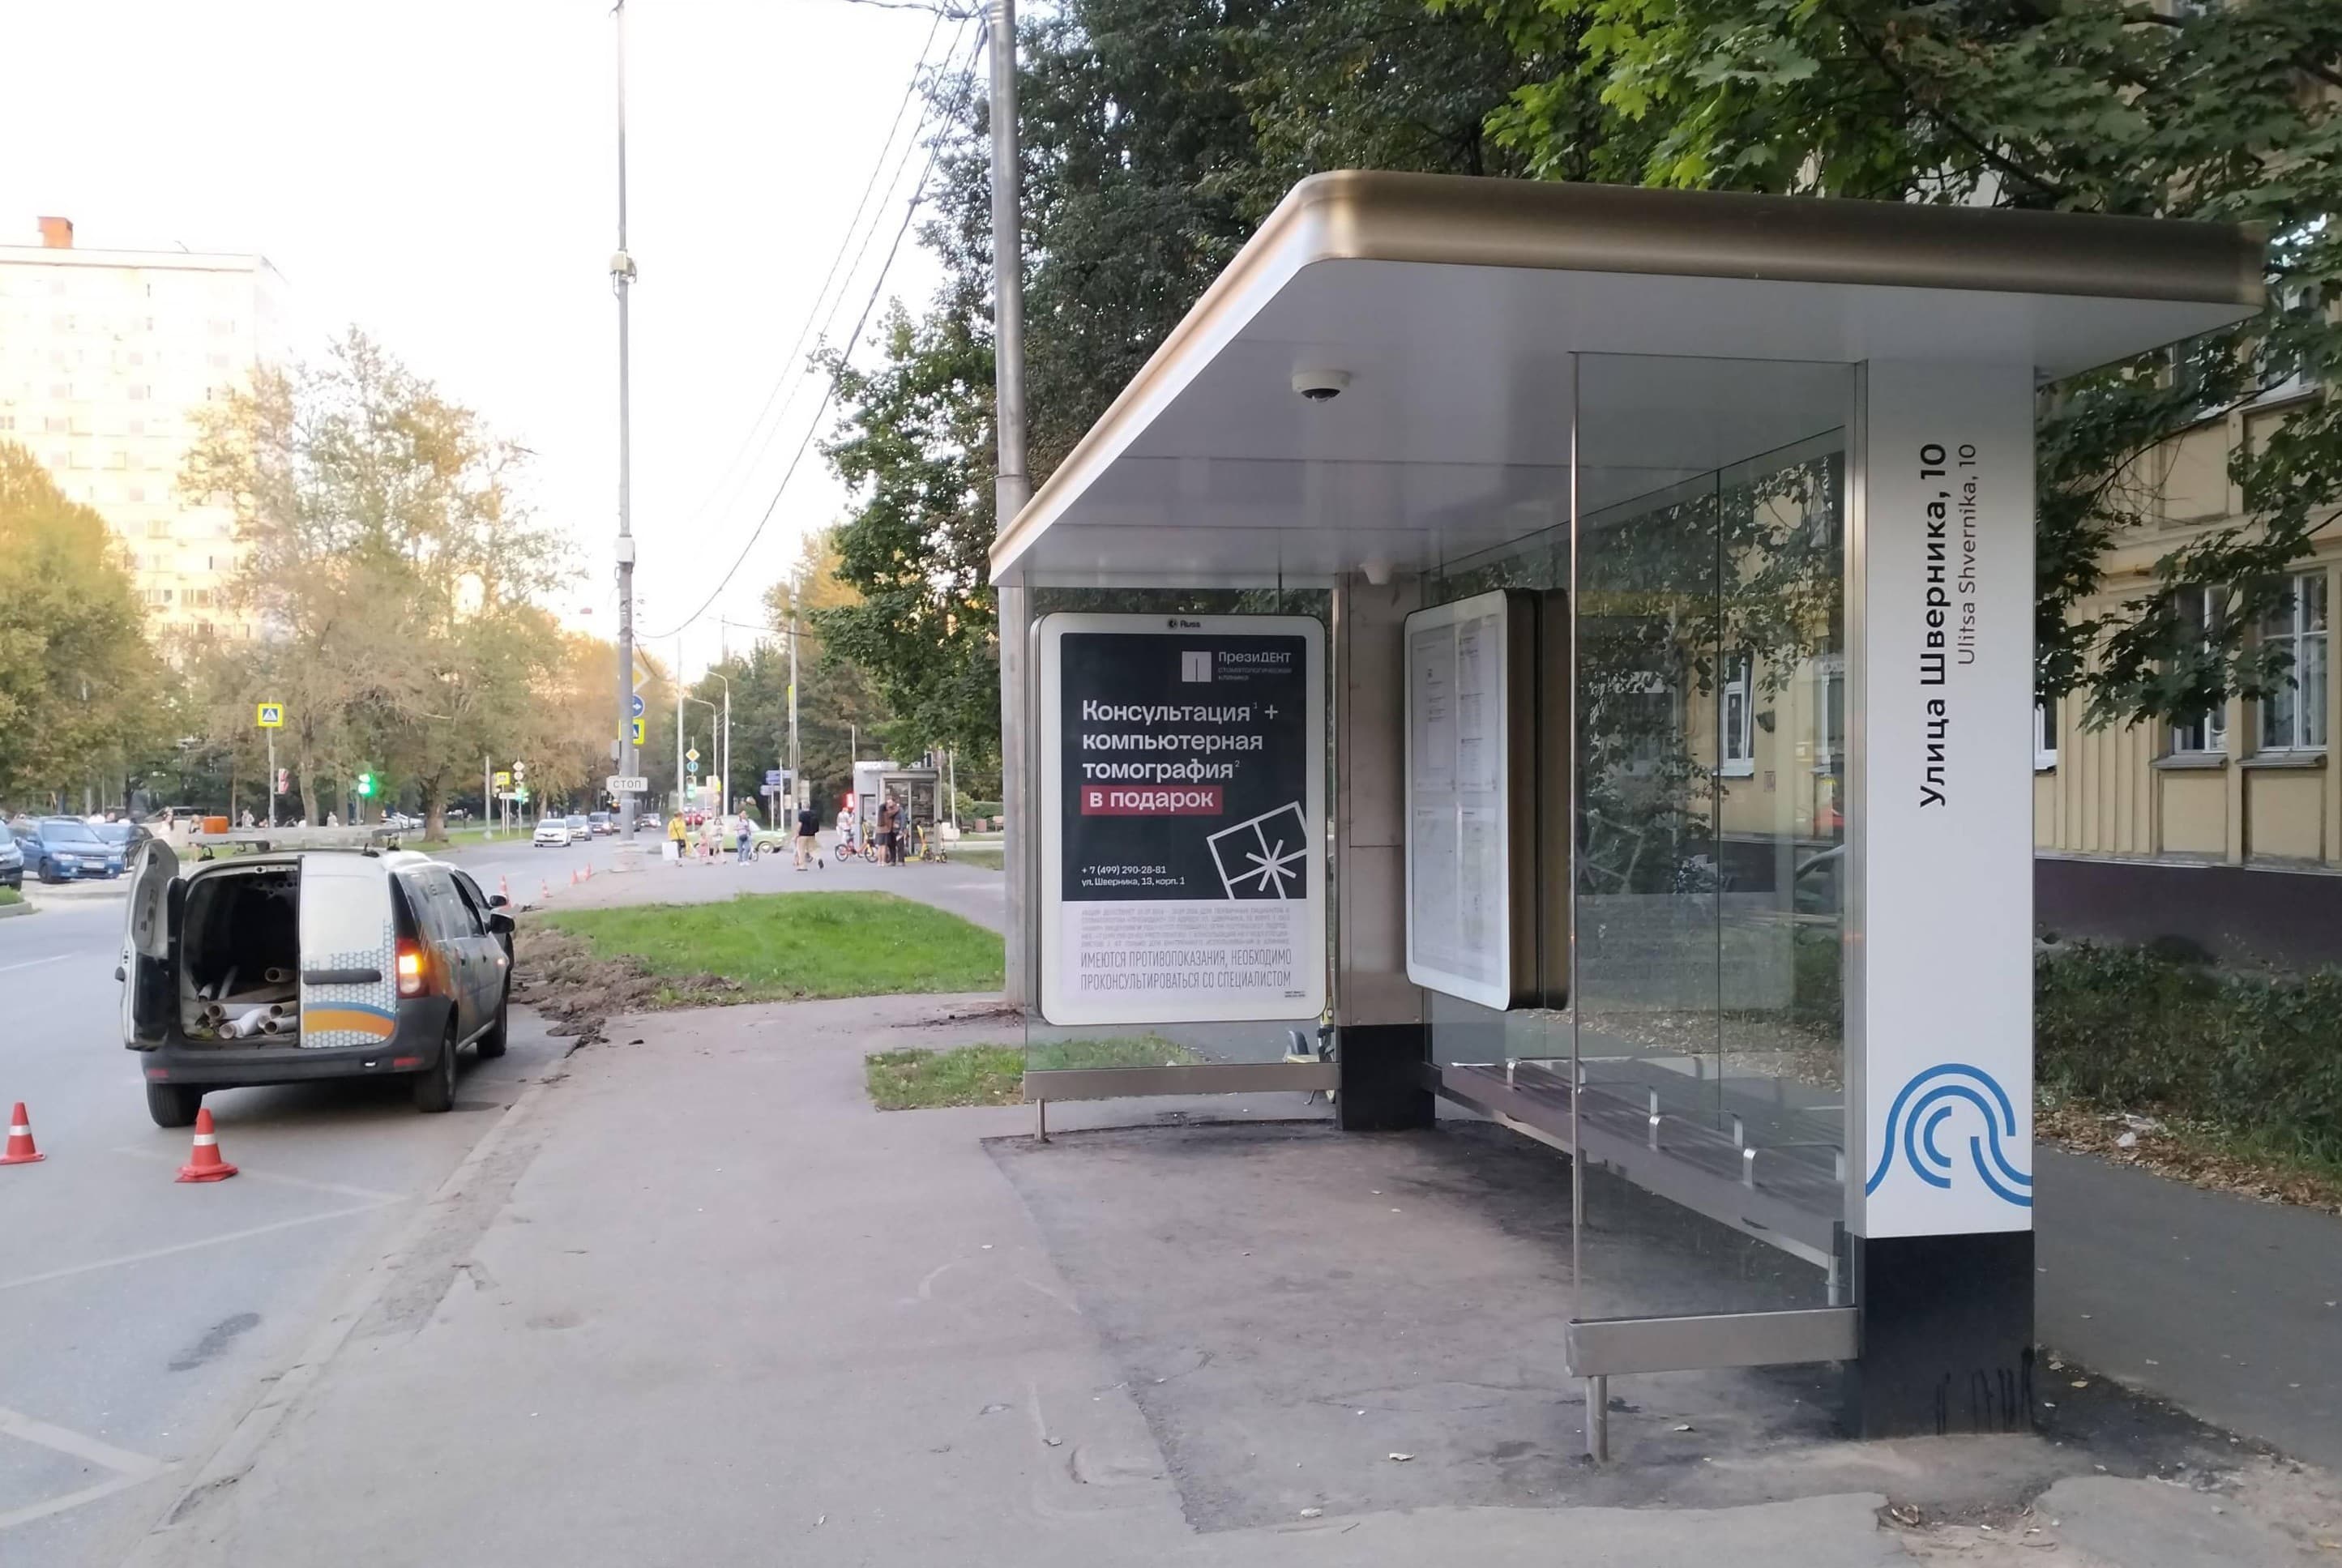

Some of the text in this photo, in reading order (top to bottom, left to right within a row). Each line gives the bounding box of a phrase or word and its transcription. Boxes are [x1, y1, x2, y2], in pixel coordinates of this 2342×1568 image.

[1957, 444, 1979, 664] Ulitsa Shvernika, 10
[1180, 620, 1201, 629] Russ
[1920, 443, 1951, 808] Улица Шверника, 10
[1218, 652, 1292, 664] ПрезиДЕНТ
[1264, 704, 1279, 720] +
[1083, 734, 1263, 754] компьютерная
[613, 780, 641, 788] СТОП
[1089, 792, 1214, 812] в подарок
[1089, 865, 1096, 874] 7
[1097, 865, 1120, 875] (499)
[1122, 865, 1167, 874] 290-28-81
[1081, 878, 1094, 887] ул.
[1095, 878, 1140, 887] Шверника,
[1156, 878, 1179, 887] корп.
[1179, 877, 1186, 885] 1
[1081, 949, 1292, 968] ИМЕЮТСЯ ПРОТИВОПОКАЗАНИЯ, НЕОБХОДИМО
[1080, 971, 1291, 990] ПРОКОНСУЛЬТИРОВАТЬСЯ СО СПЕЦИАЛИСТОМ
